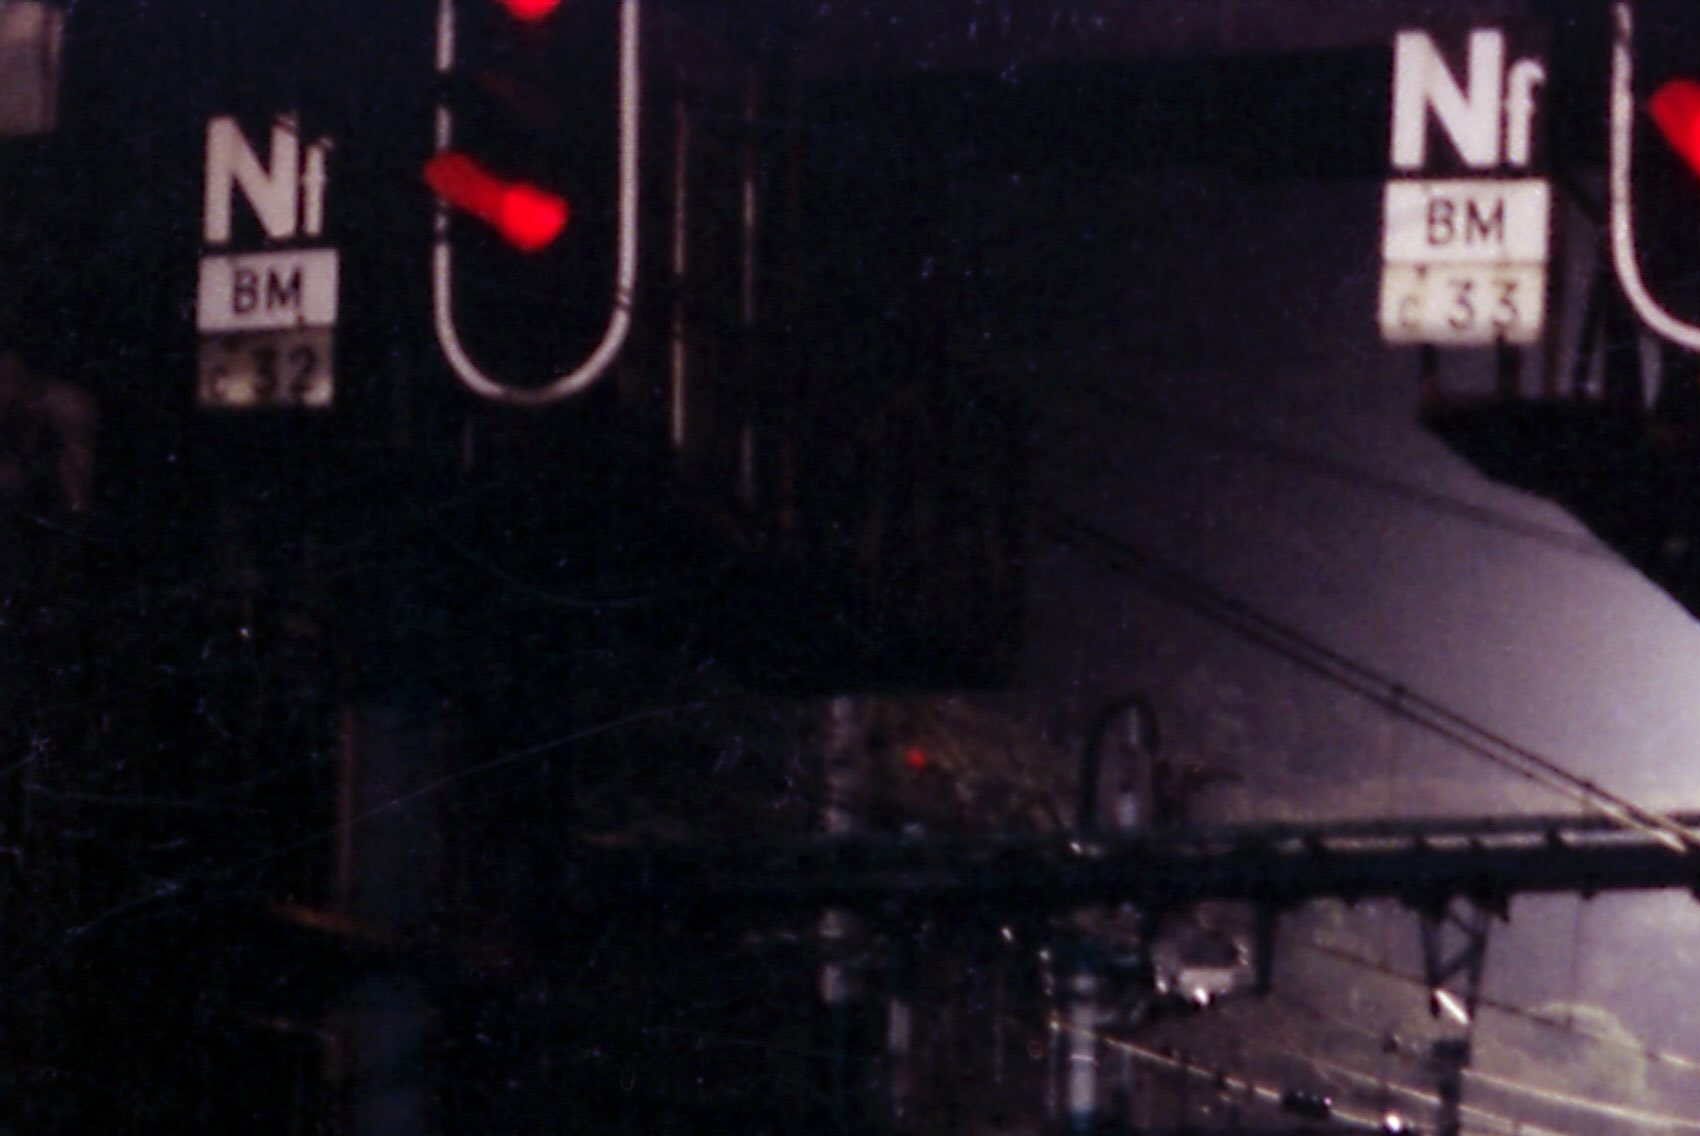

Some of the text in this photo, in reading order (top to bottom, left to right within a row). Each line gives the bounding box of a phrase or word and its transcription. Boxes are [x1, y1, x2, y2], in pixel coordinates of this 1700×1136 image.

[1390, 26, 1546, 170] Nf
[1427, 197, 1505, 246] BM
[232, 268, 304, 315] BM
[1447, 279, 1519, 332] 33
